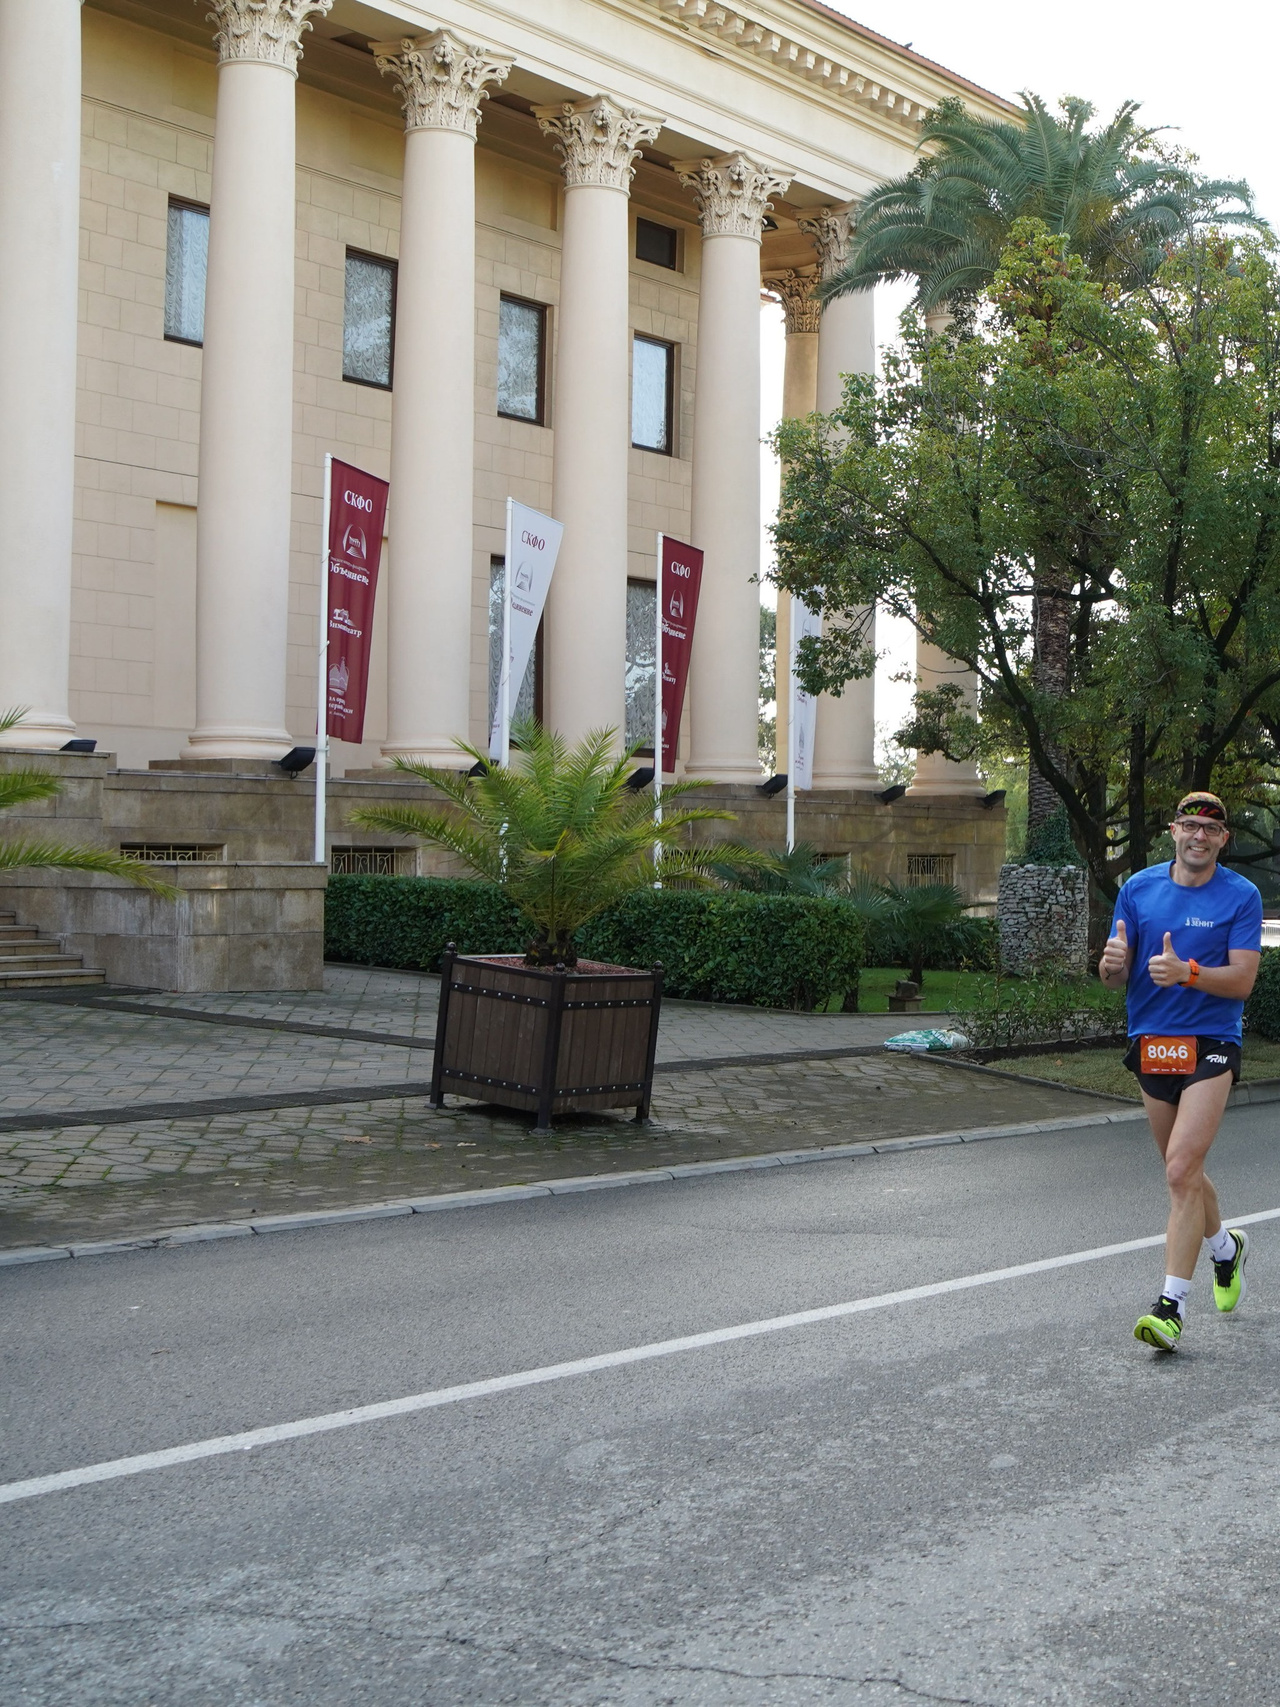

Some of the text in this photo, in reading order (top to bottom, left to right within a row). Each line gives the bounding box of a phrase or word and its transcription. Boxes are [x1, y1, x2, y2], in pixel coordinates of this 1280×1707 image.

[344, 490, 373, 513] СКФО
[521, 530, 546, 551] СКФО
[671, 561, 691, 579] СКФО
[1147, 1045, 1189, 1060] 8046
